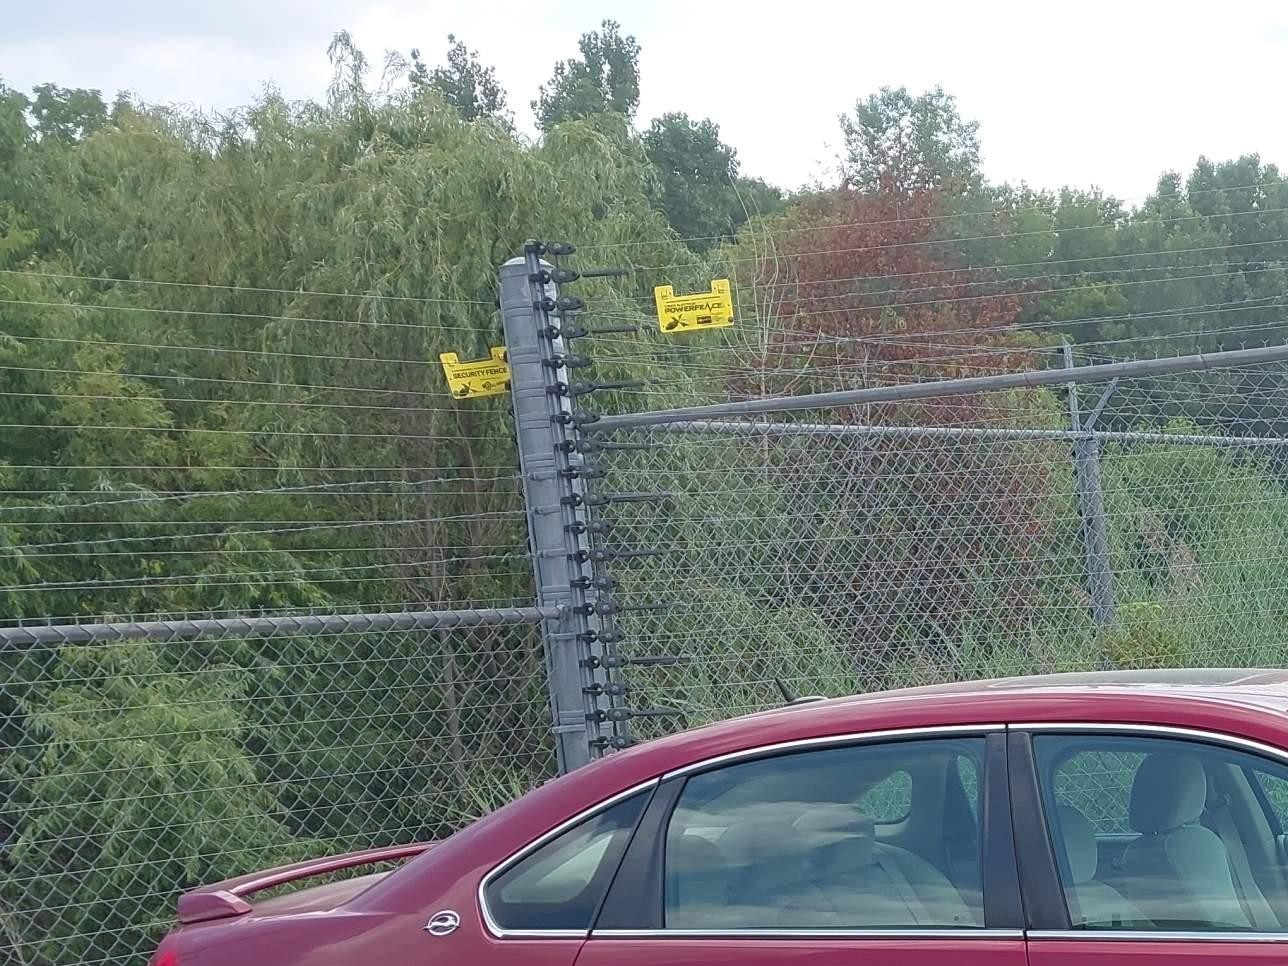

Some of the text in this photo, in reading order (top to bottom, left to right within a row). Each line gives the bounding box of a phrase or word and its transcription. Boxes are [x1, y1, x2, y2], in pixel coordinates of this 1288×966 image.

[664, 302, 723, 314] POWERFENCE
[453, 370, 485, 379] SECURITY
[486, 367, 507, 376] FENCE
